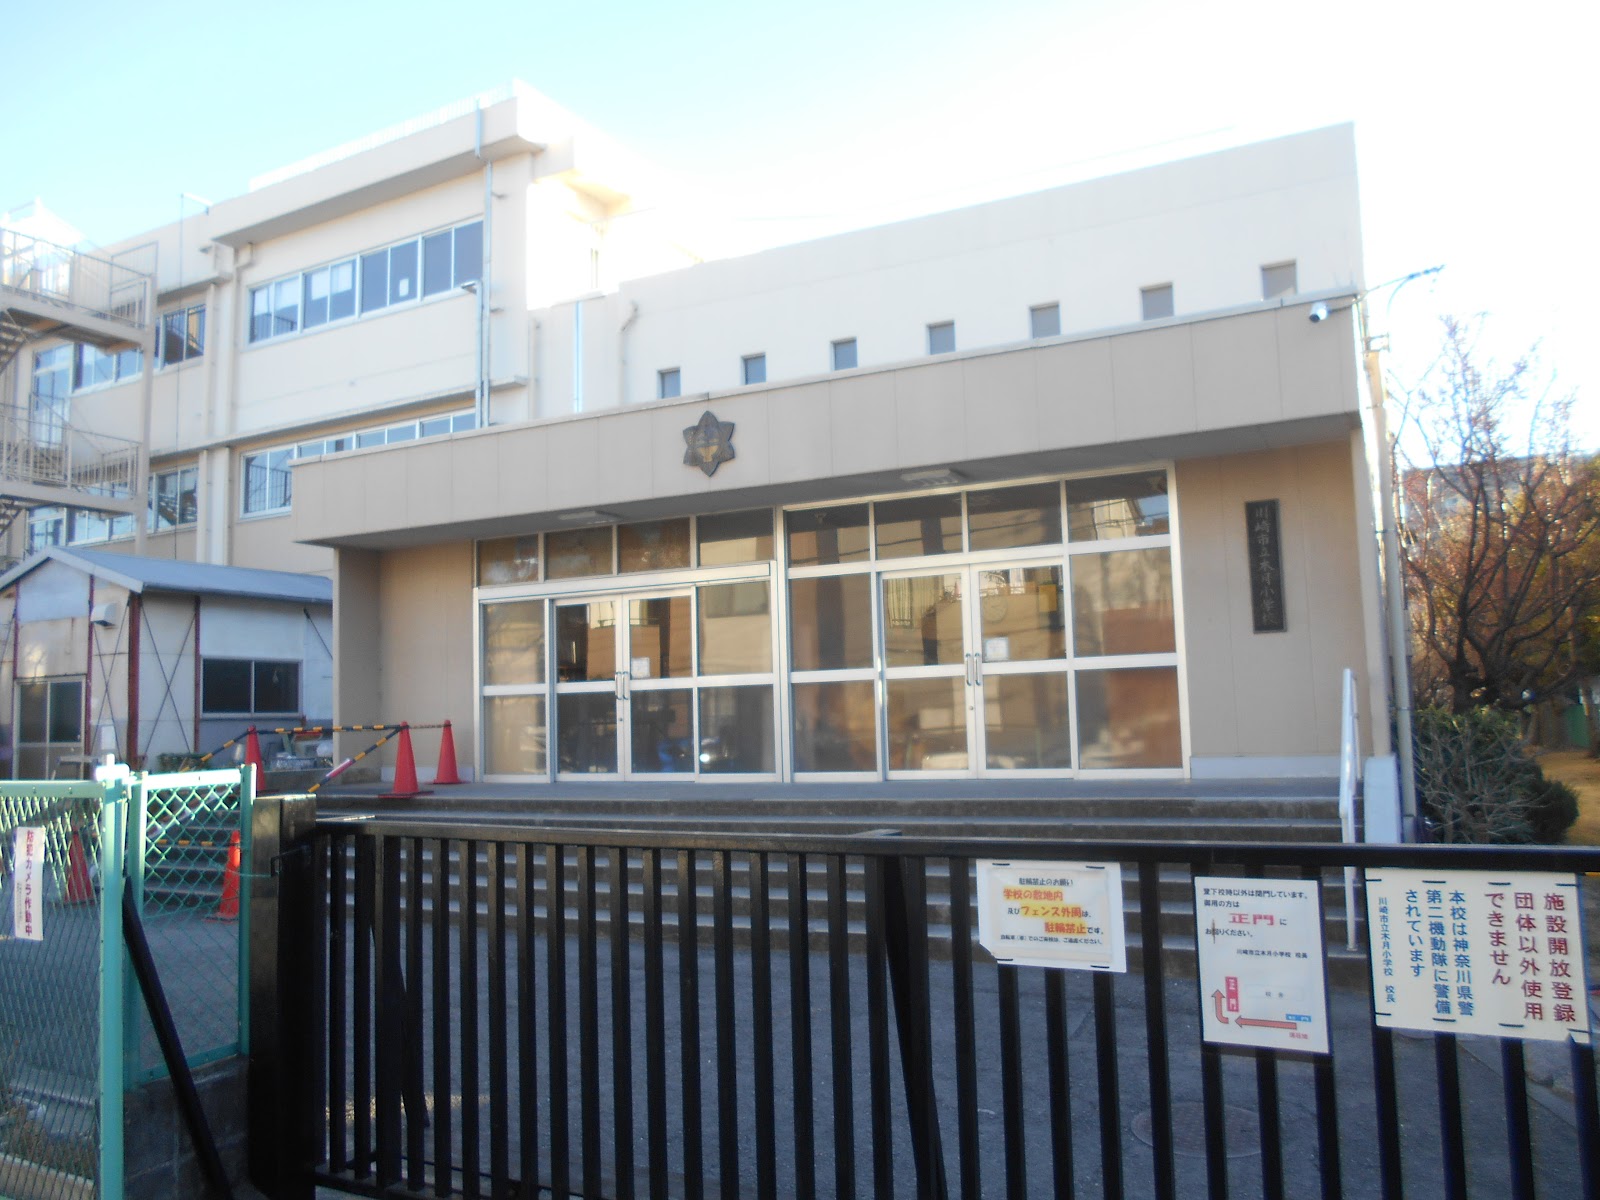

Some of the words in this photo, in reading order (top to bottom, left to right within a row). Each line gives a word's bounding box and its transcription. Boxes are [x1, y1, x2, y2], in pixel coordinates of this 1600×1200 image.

[1003, 888, 1064, 901] 学校の敷地内
[1204, 899, 1240, 908] 御用の方は
[1228, 912, 1274, 926] 正門
[1279, 918, 1287, 926] に
[1378, 897, 1393, 977] 川崎市立木月小学校
[1405, 889, 1425, 978] されています
[1426, 889, 1451, 1014] 第二機動隊に警備
[1449, 890, 1474, 1017] 本校は神奈川県警
[1484, 893, 1511, 986] できません
[1514, 892, 1544, 1021] 団体以外使用
[1542, 892, 1576, 1023] 施設開放登録
[1385, 985, 1396, 1004] 校長
